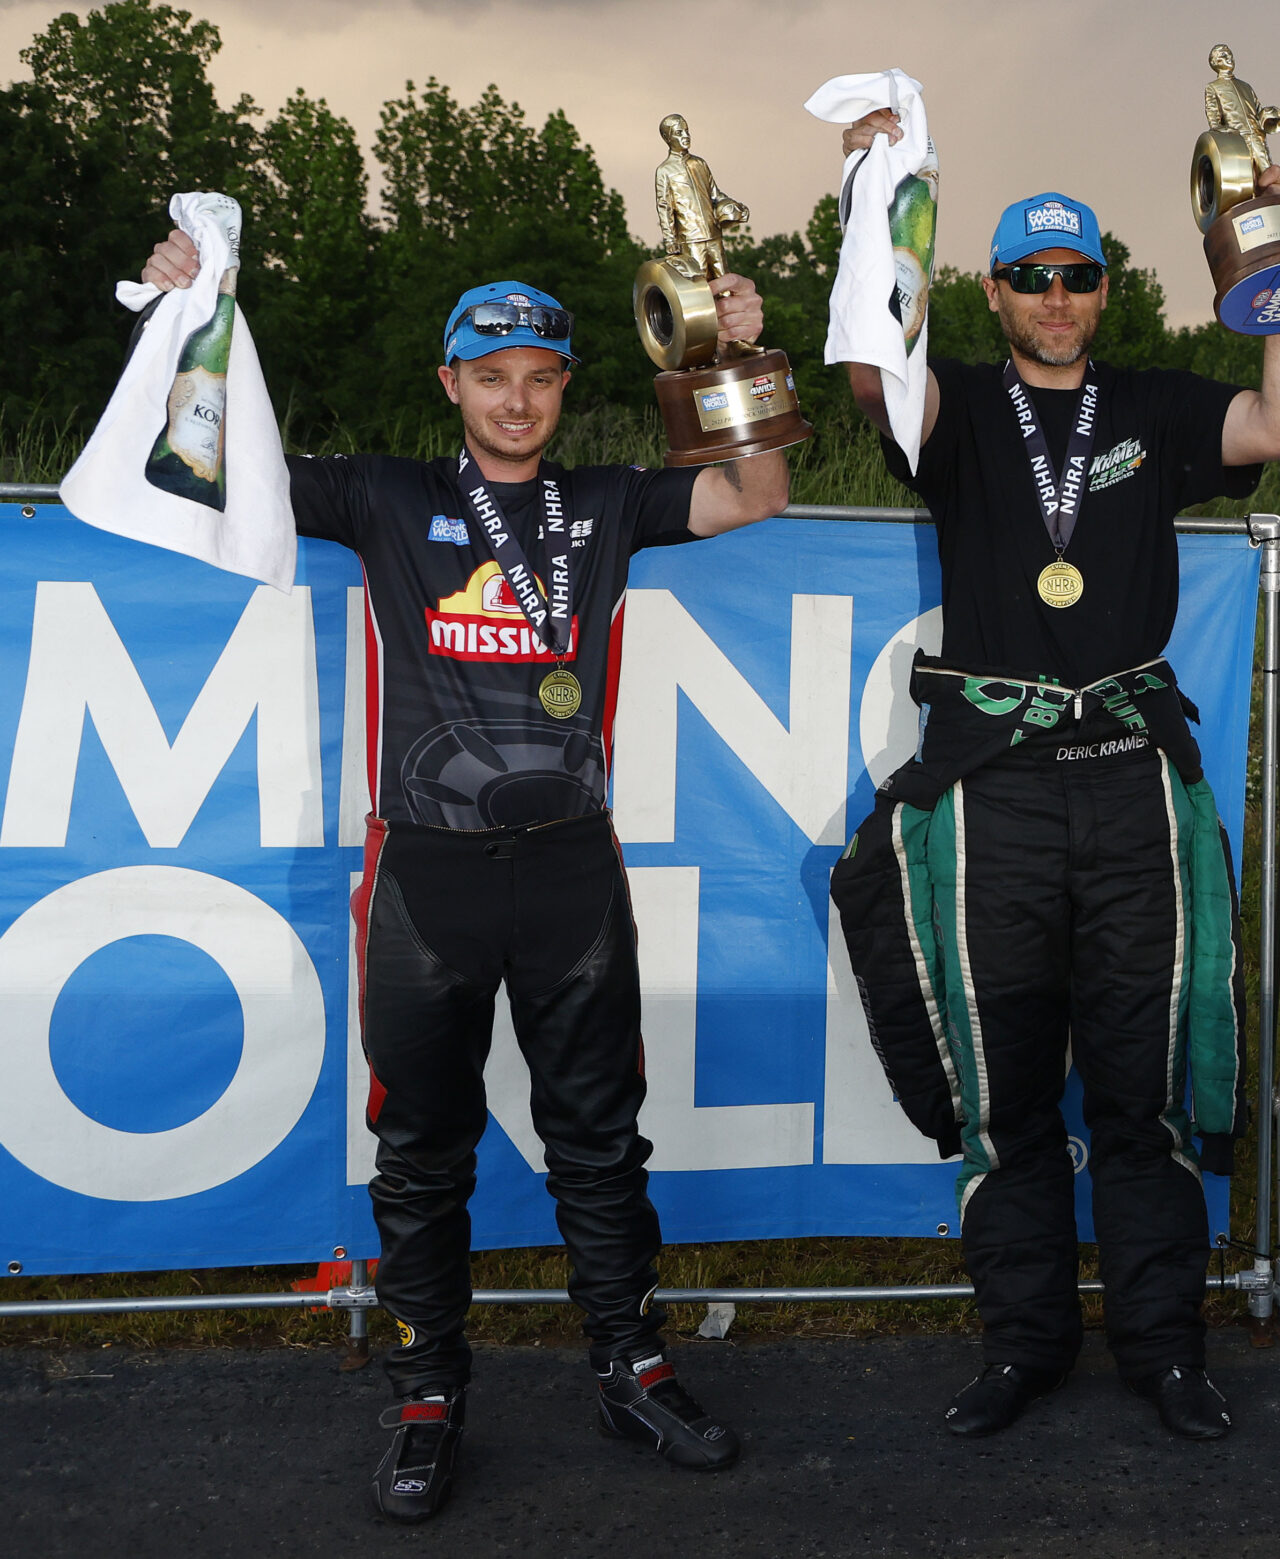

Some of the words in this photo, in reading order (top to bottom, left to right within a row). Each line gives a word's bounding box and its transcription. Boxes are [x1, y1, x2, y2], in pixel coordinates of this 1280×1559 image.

[1028, 208, 1079, 222] CAMPING
[1029, 216, 1079, 229] WORLD
[750, 382, 777, 395] 4WIDE
[1008, 383, 1036, 438] NHRA
[1076, 384, 1098, 436] NHRA
[543, 480, 565, 532] NHRA
[1030, 454, 1059, 516] NHRA
[1059, 456, 1086, 515] NHRA
[469, 486, 509, 548] NHRA
[508, 563, 547, 627] NHRA
[551, 554, 569, 619] NHRA
[1046, 578, 1075, 592] NHRA
[548, 684, 576, 702] NHRA
[1056, 744, 1099, 761] DERIC
